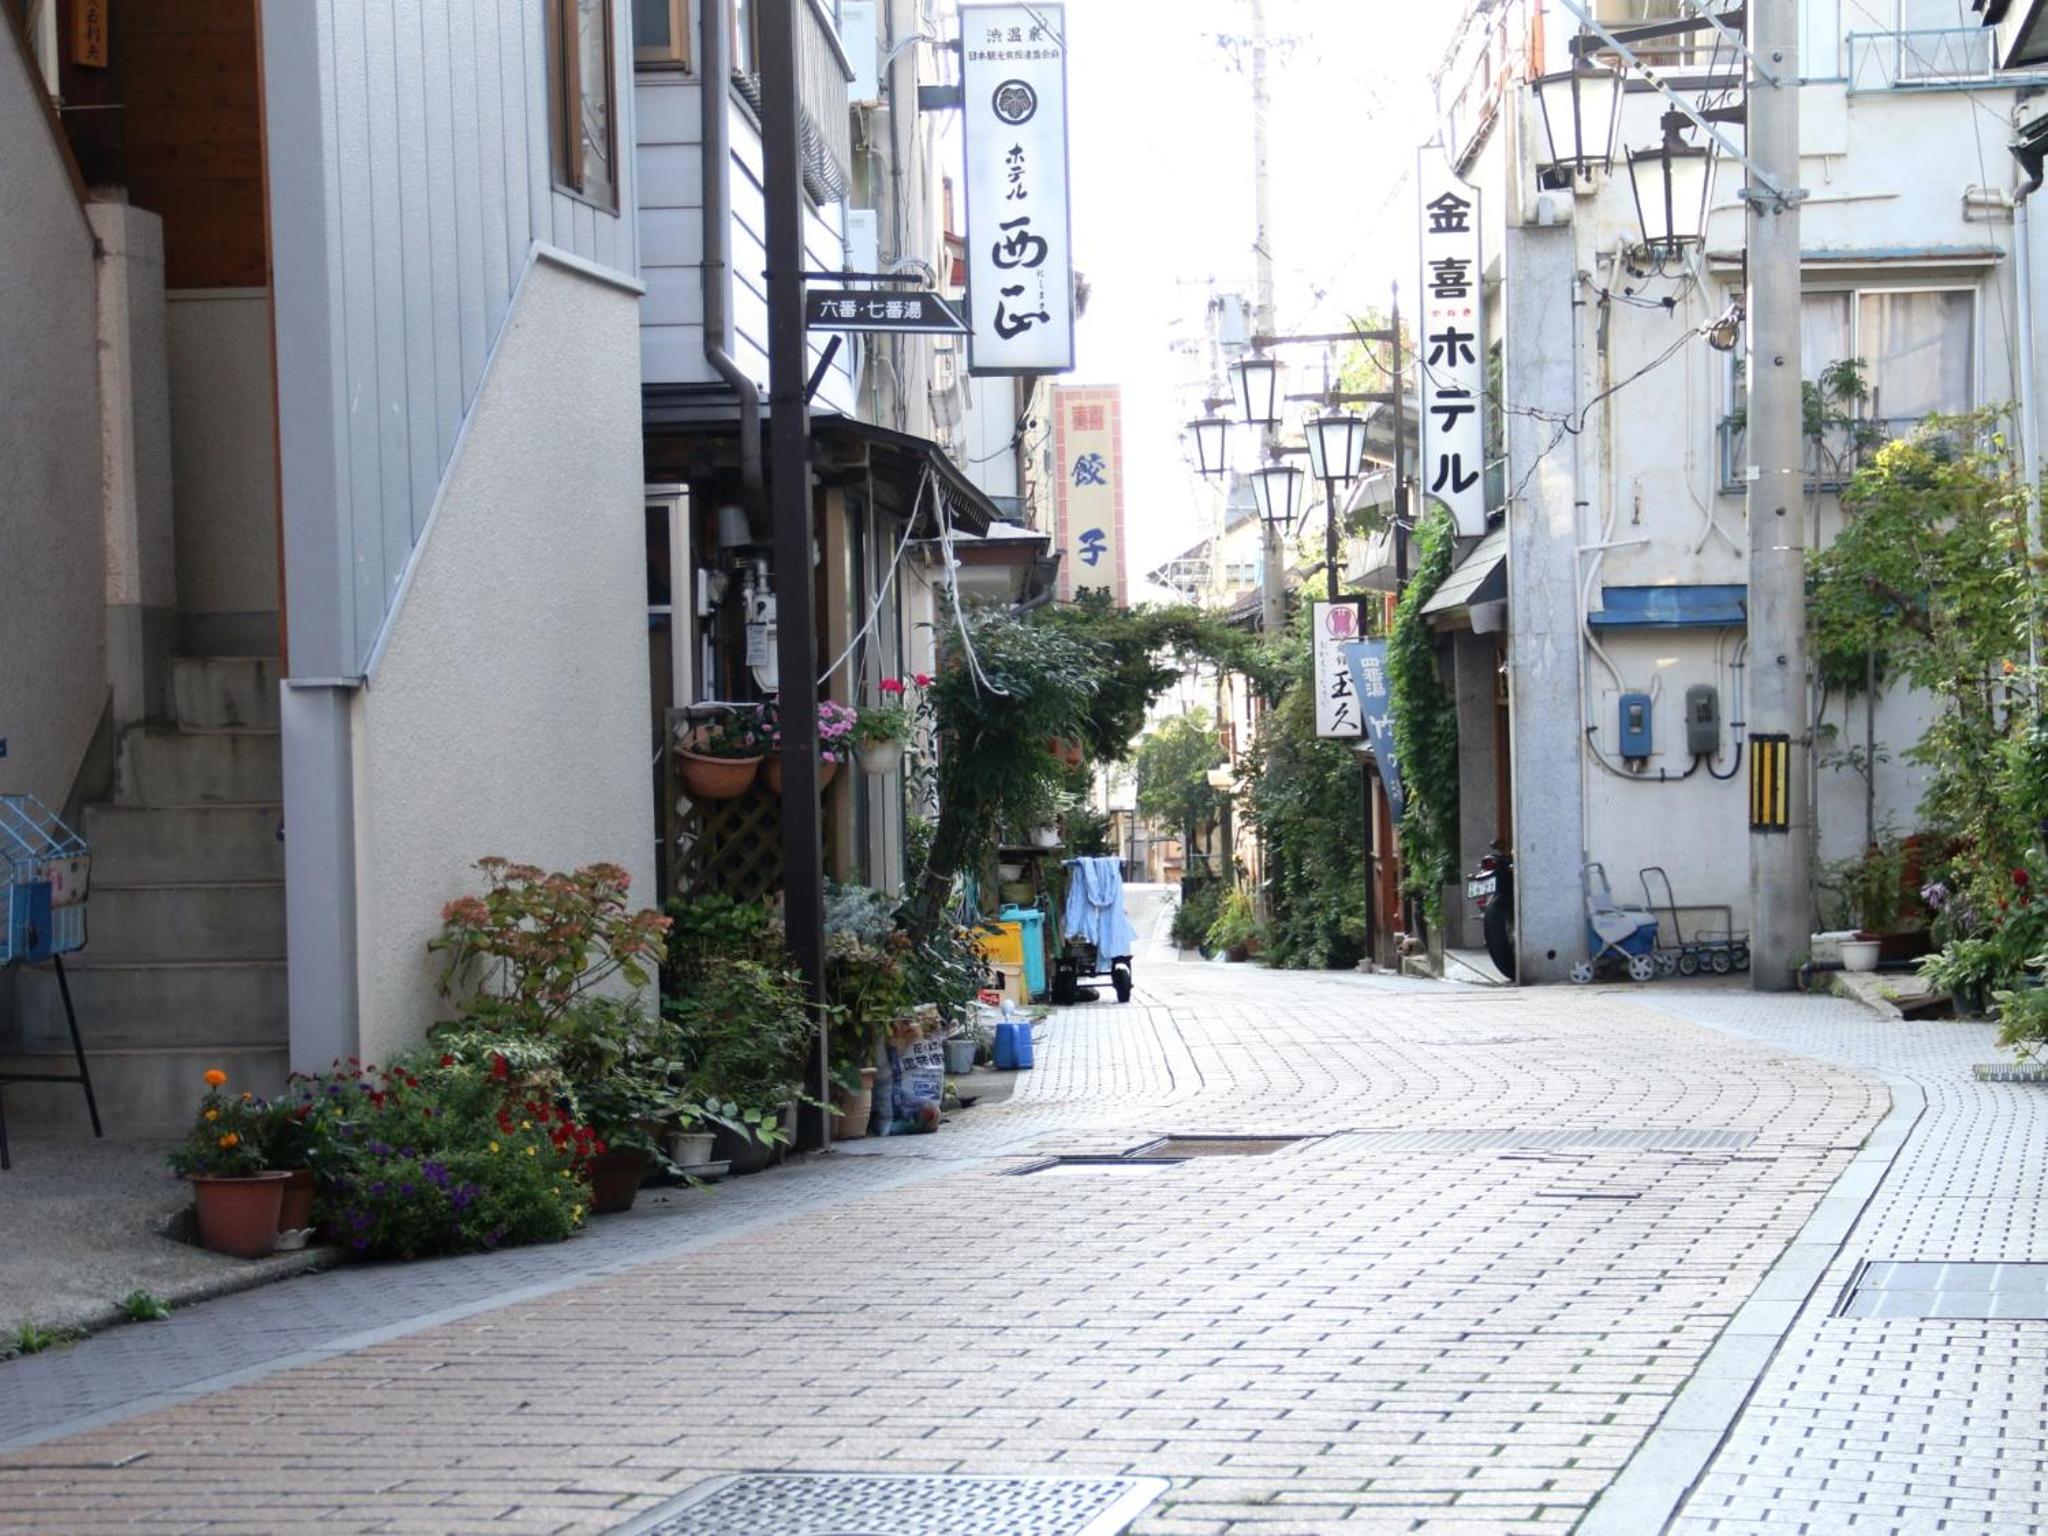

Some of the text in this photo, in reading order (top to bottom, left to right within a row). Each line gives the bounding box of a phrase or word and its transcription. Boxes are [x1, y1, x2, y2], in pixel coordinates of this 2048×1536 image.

[986, 27, 1043, 43] 渋温泉
[1005, 143, 1028, 201] ホテル
[1071, 452, 1108, 568] 餃子
